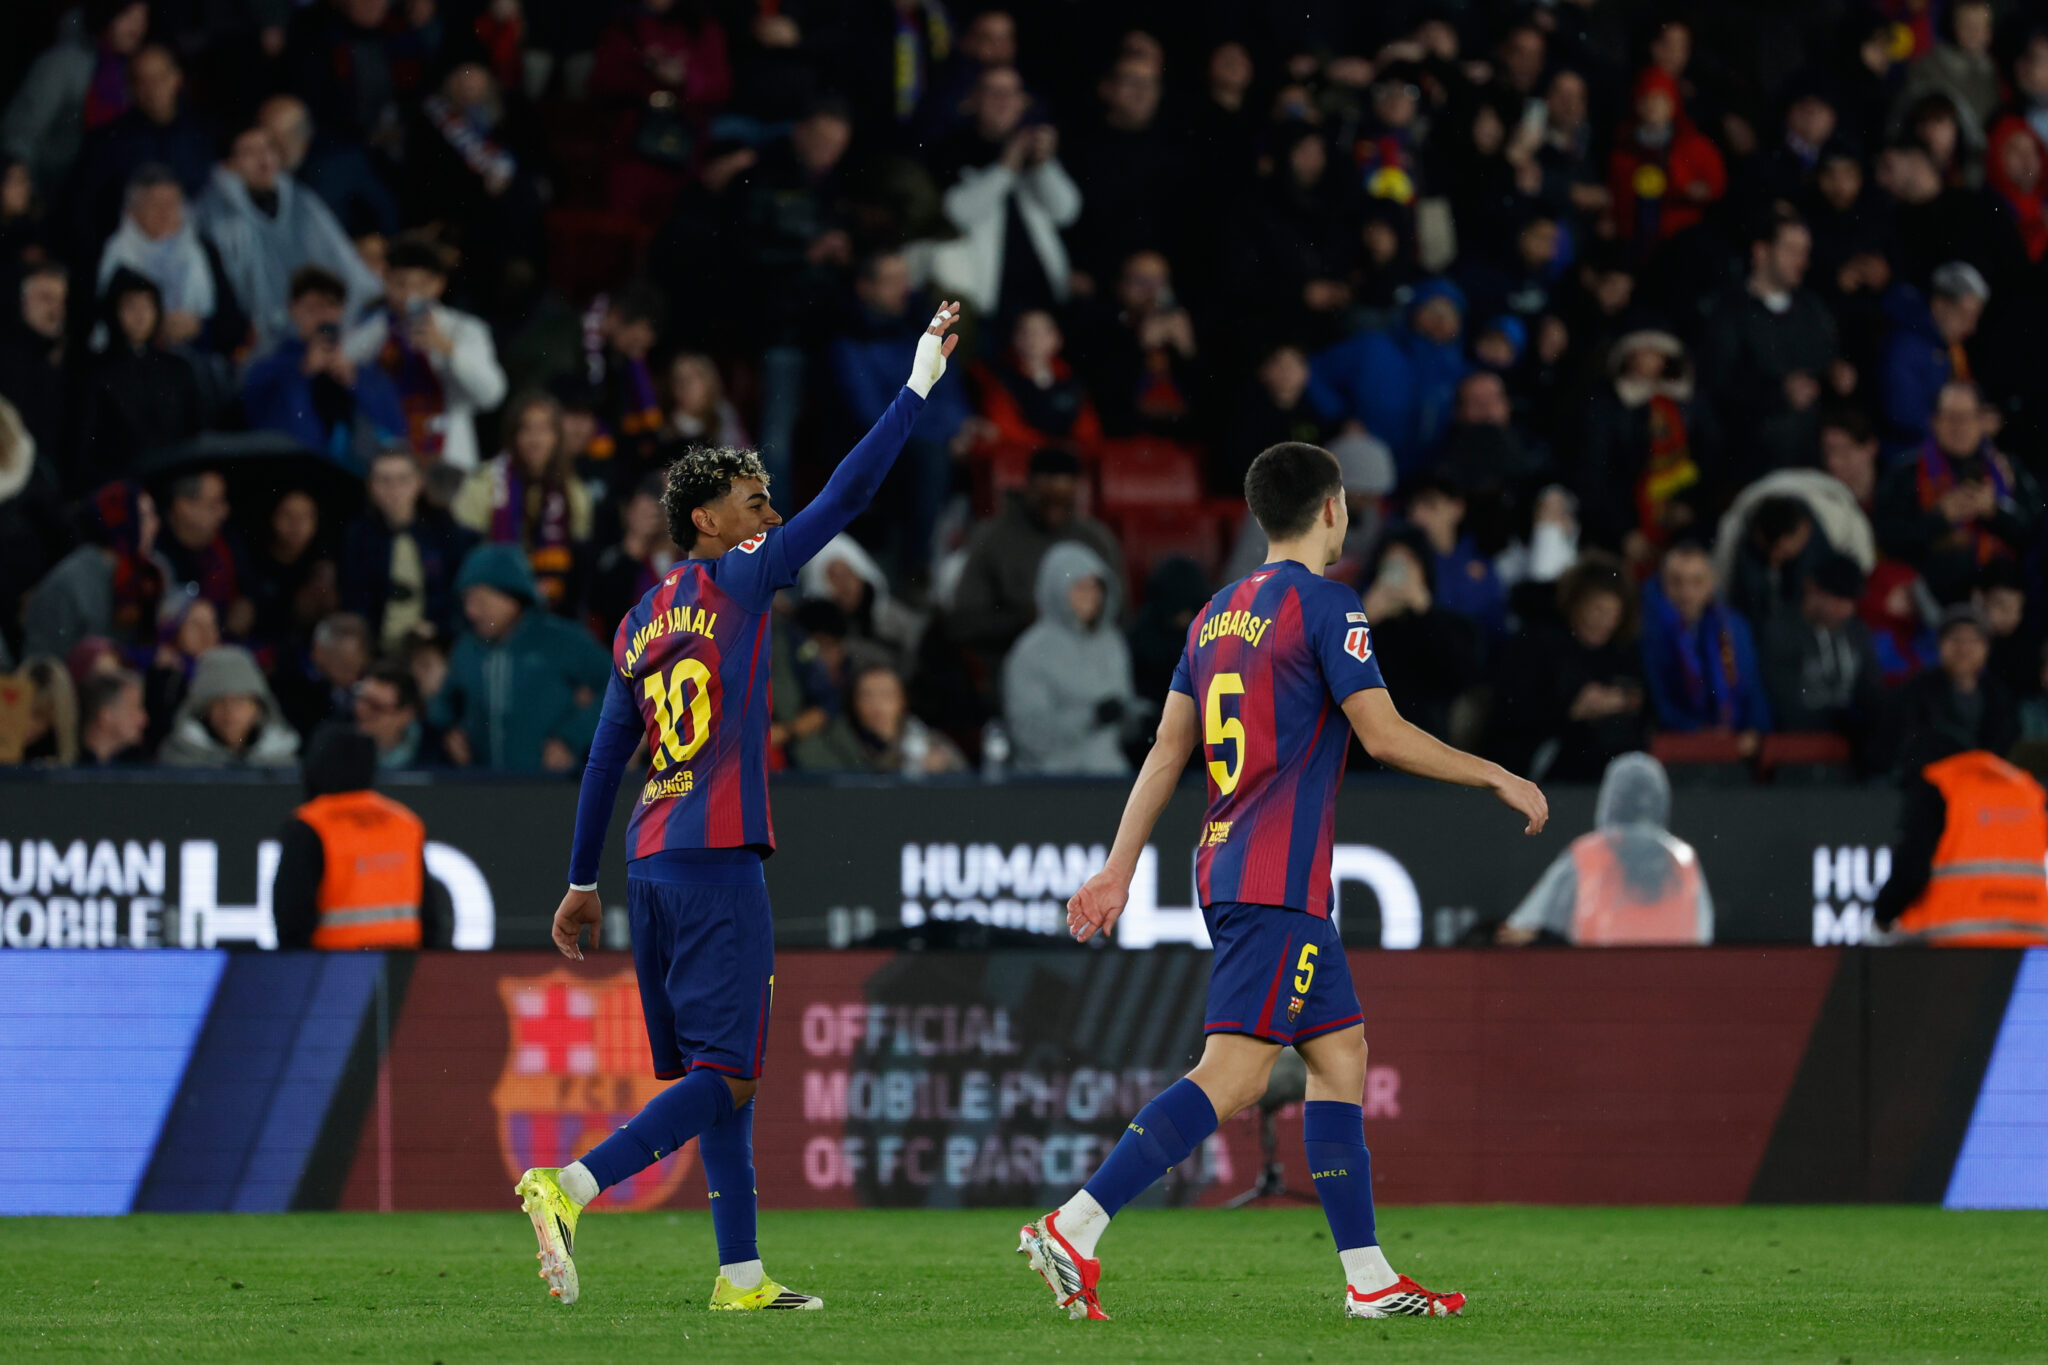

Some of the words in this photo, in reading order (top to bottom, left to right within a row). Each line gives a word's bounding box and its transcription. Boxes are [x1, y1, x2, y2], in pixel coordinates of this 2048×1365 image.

[620, 613, 665, 679] LAMINE
[666, 605, 718, 640] YAMAL
[1199, 609, 1273, 648] CUBARSÍ
[643, 657, 713, 772] 10
[1205, 673, 1245, 796] 5
[901, 842, 1110, 899] HUMAN
[0, 897, 163, 949] OBILE
[1294, 942, 1319, 994] 5
[803, 1003, 1017, 1056] OFFICIAL
[803, 1068, 991, 1121] MOBILE
[804, 1135, 866, 1189] OF
[876, 1135, 935, 1188] FC
